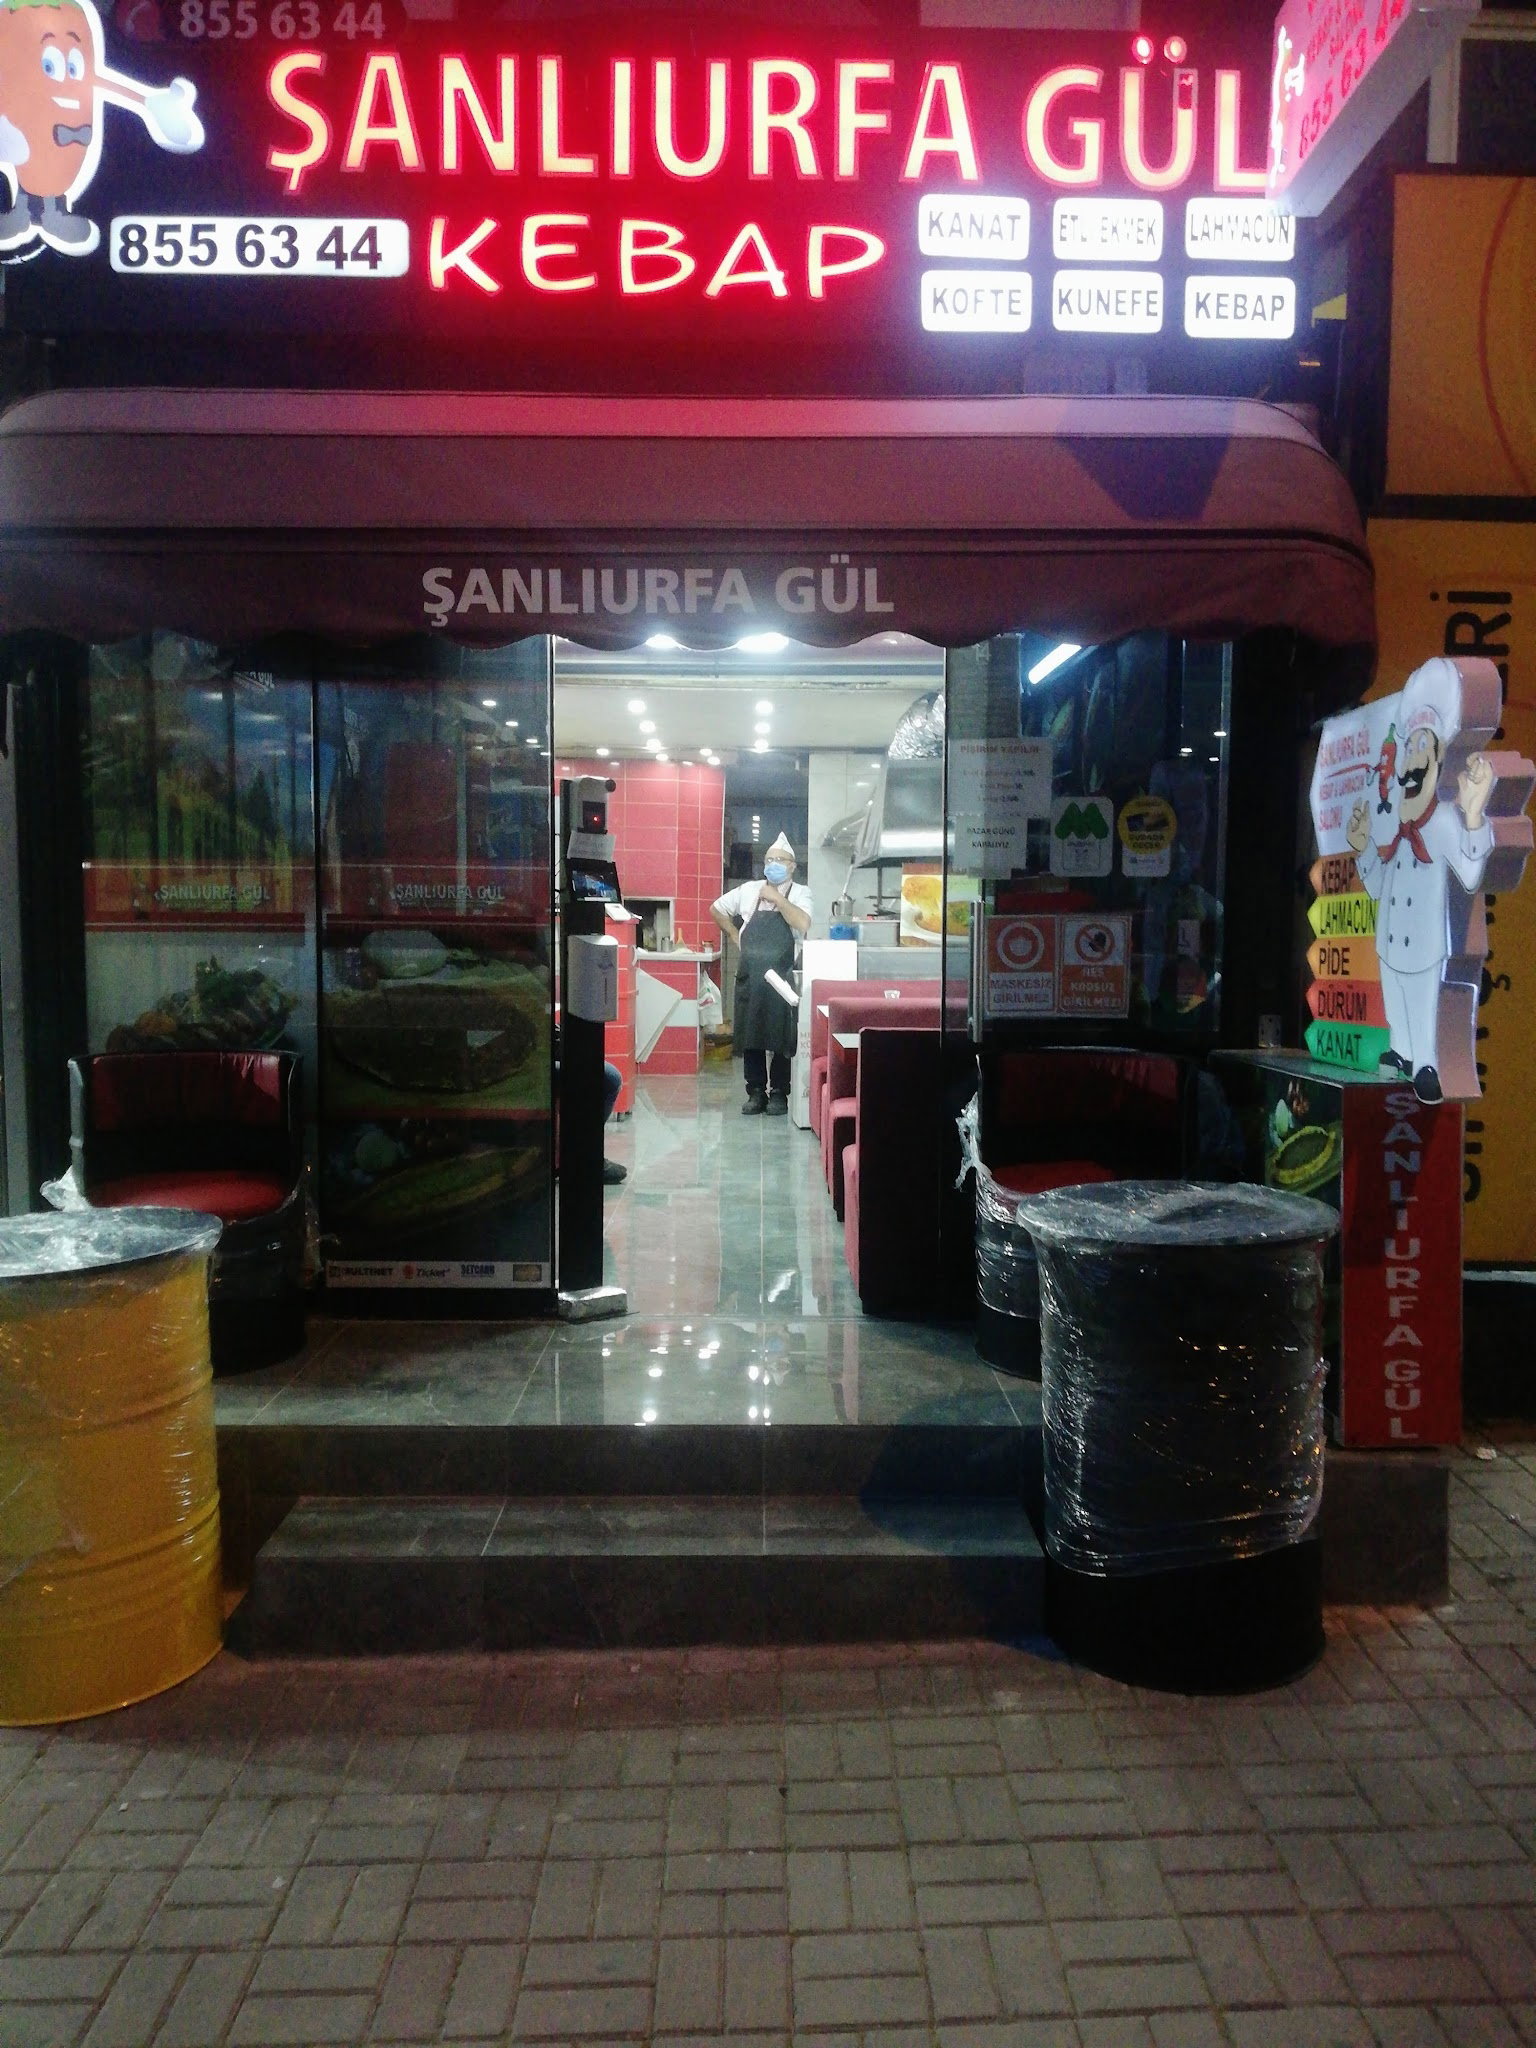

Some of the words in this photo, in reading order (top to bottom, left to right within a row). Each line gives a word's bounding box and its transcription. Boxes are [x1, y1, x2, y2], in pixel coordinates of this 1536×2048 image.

[180, 0, 258, 39] 855
[270, 0, 321, 40] 63
[333, 0, 386, 40] 44
[266, 51, 983, 195] ŞANLIURFA
[1022, 35, 1269, 192] GÜL
[928, 210, 1021, 242] KANAT
[119, 222, 218, 269] 855
[234, 224, 300, 269] 63
[315, 225, 383, 270] 44
[427, 213, 887, 300] KEBAP
[1194, 291, 1286, 322] KEBAP
[421, 566, 758, 628] ŞANLIURFA
[774, 553, 895, 614] GÜL
[1321, 857, 1355, 894] KEBAP
[1320, 899, 1377, 936] LAHMACUN
[1319, 941, 1351, 976] PİDE
[1317, 984, 1367, 1022] DÜRÜM
[1316, 1029, 1362, 1064] KANAT
